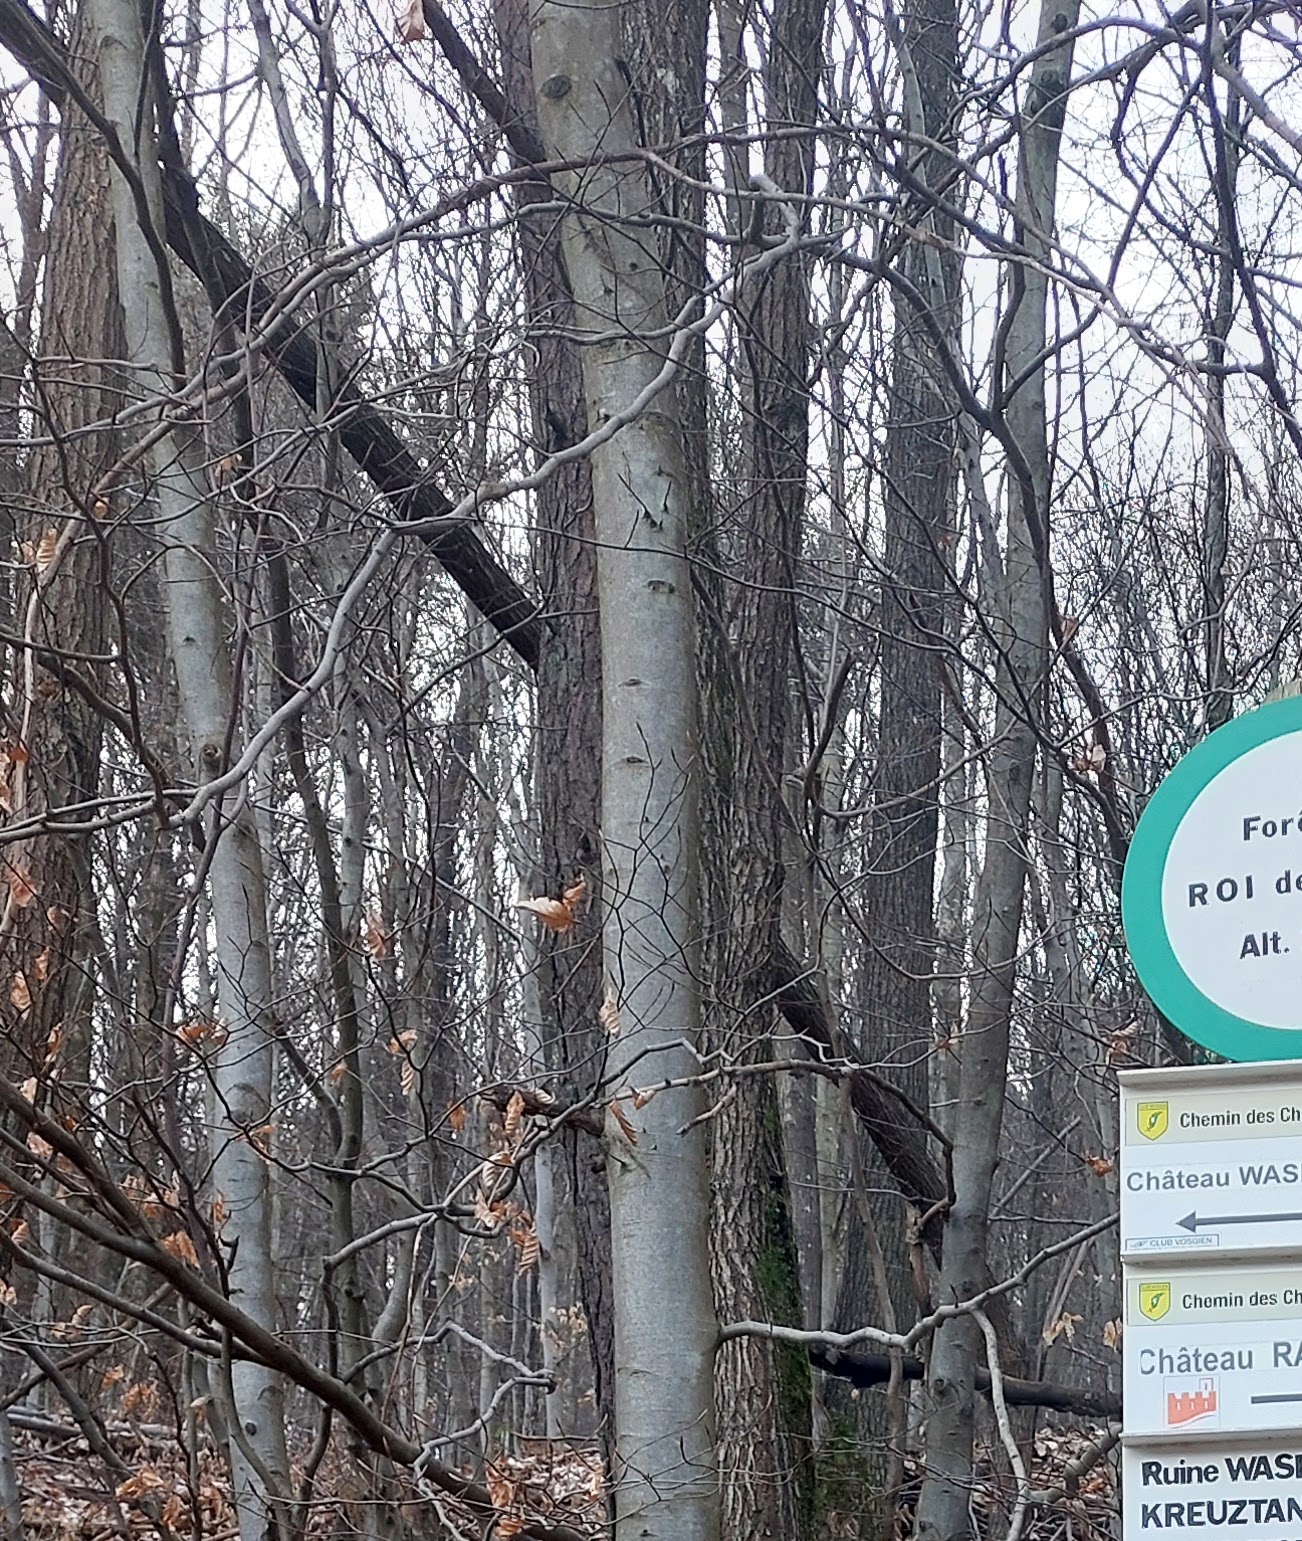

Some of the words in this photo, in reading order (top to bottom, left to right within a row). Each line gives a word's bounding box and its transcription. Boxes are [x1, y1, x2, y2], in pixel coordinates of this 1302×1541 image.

[1188, 876, 1254, 907] ROI
[1239, 932, 1290, 960] Alt.
[1179, 1108, 1241, 1129] Chemin
[1246, 1107, 1276, 1125] des
[1126, 1168, 1230, 1192] Château
[1182, 1288, 1244, 1310] Chemin
[1248, 1288, 1278, 1307] des
[1139, 1346, 1254, 1375] Château
[1141, 1459, 1220, 1487] Ruine
